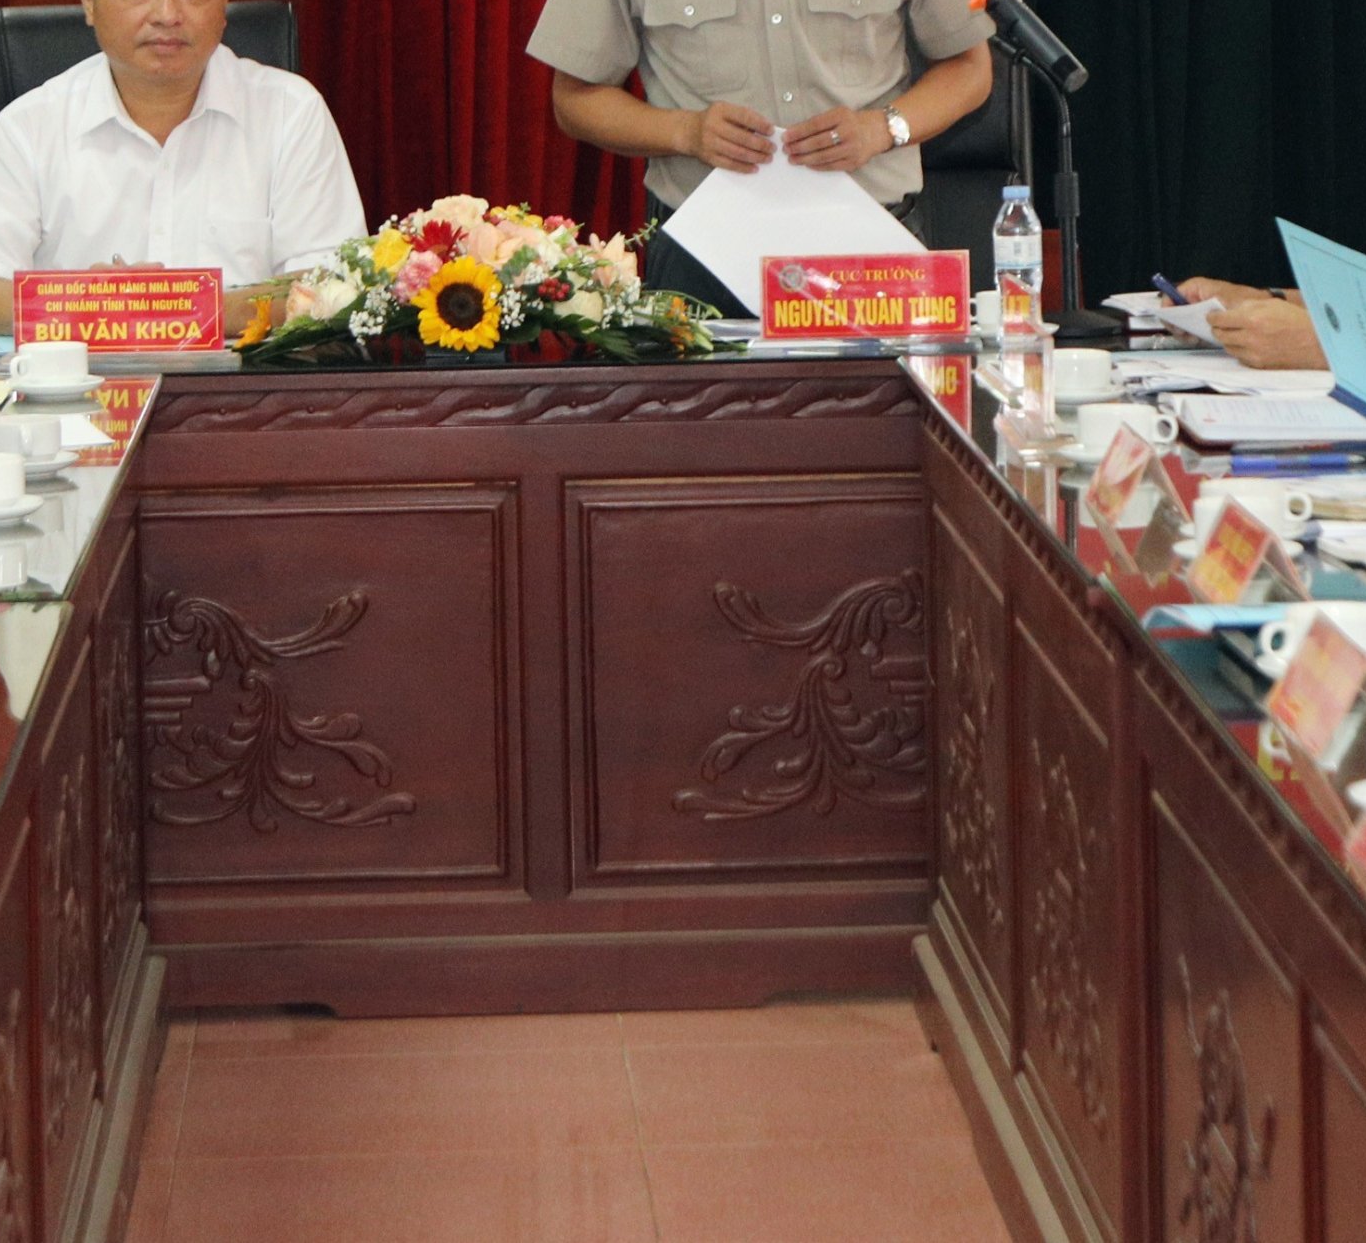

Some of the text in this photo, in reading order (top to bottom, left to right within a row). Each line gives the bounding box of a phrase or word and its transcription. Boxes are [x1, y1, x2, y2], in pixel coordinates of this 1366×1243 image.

[830, 265, 926, 283] CỤC TRƯỞNG
[37, 279, 200, 295] GIÁM ĐỐC NGÂN HÀNG NHÀ NƯỚC
[45, 297, 192, 312] CHI NHÁNH TỈNH THÁI NGUYÊN
[774, 289, 957, 328] NGUYỄN XUÂN TÙNG
[36, 317, 203, 341] BÙI VĂN KHOA
